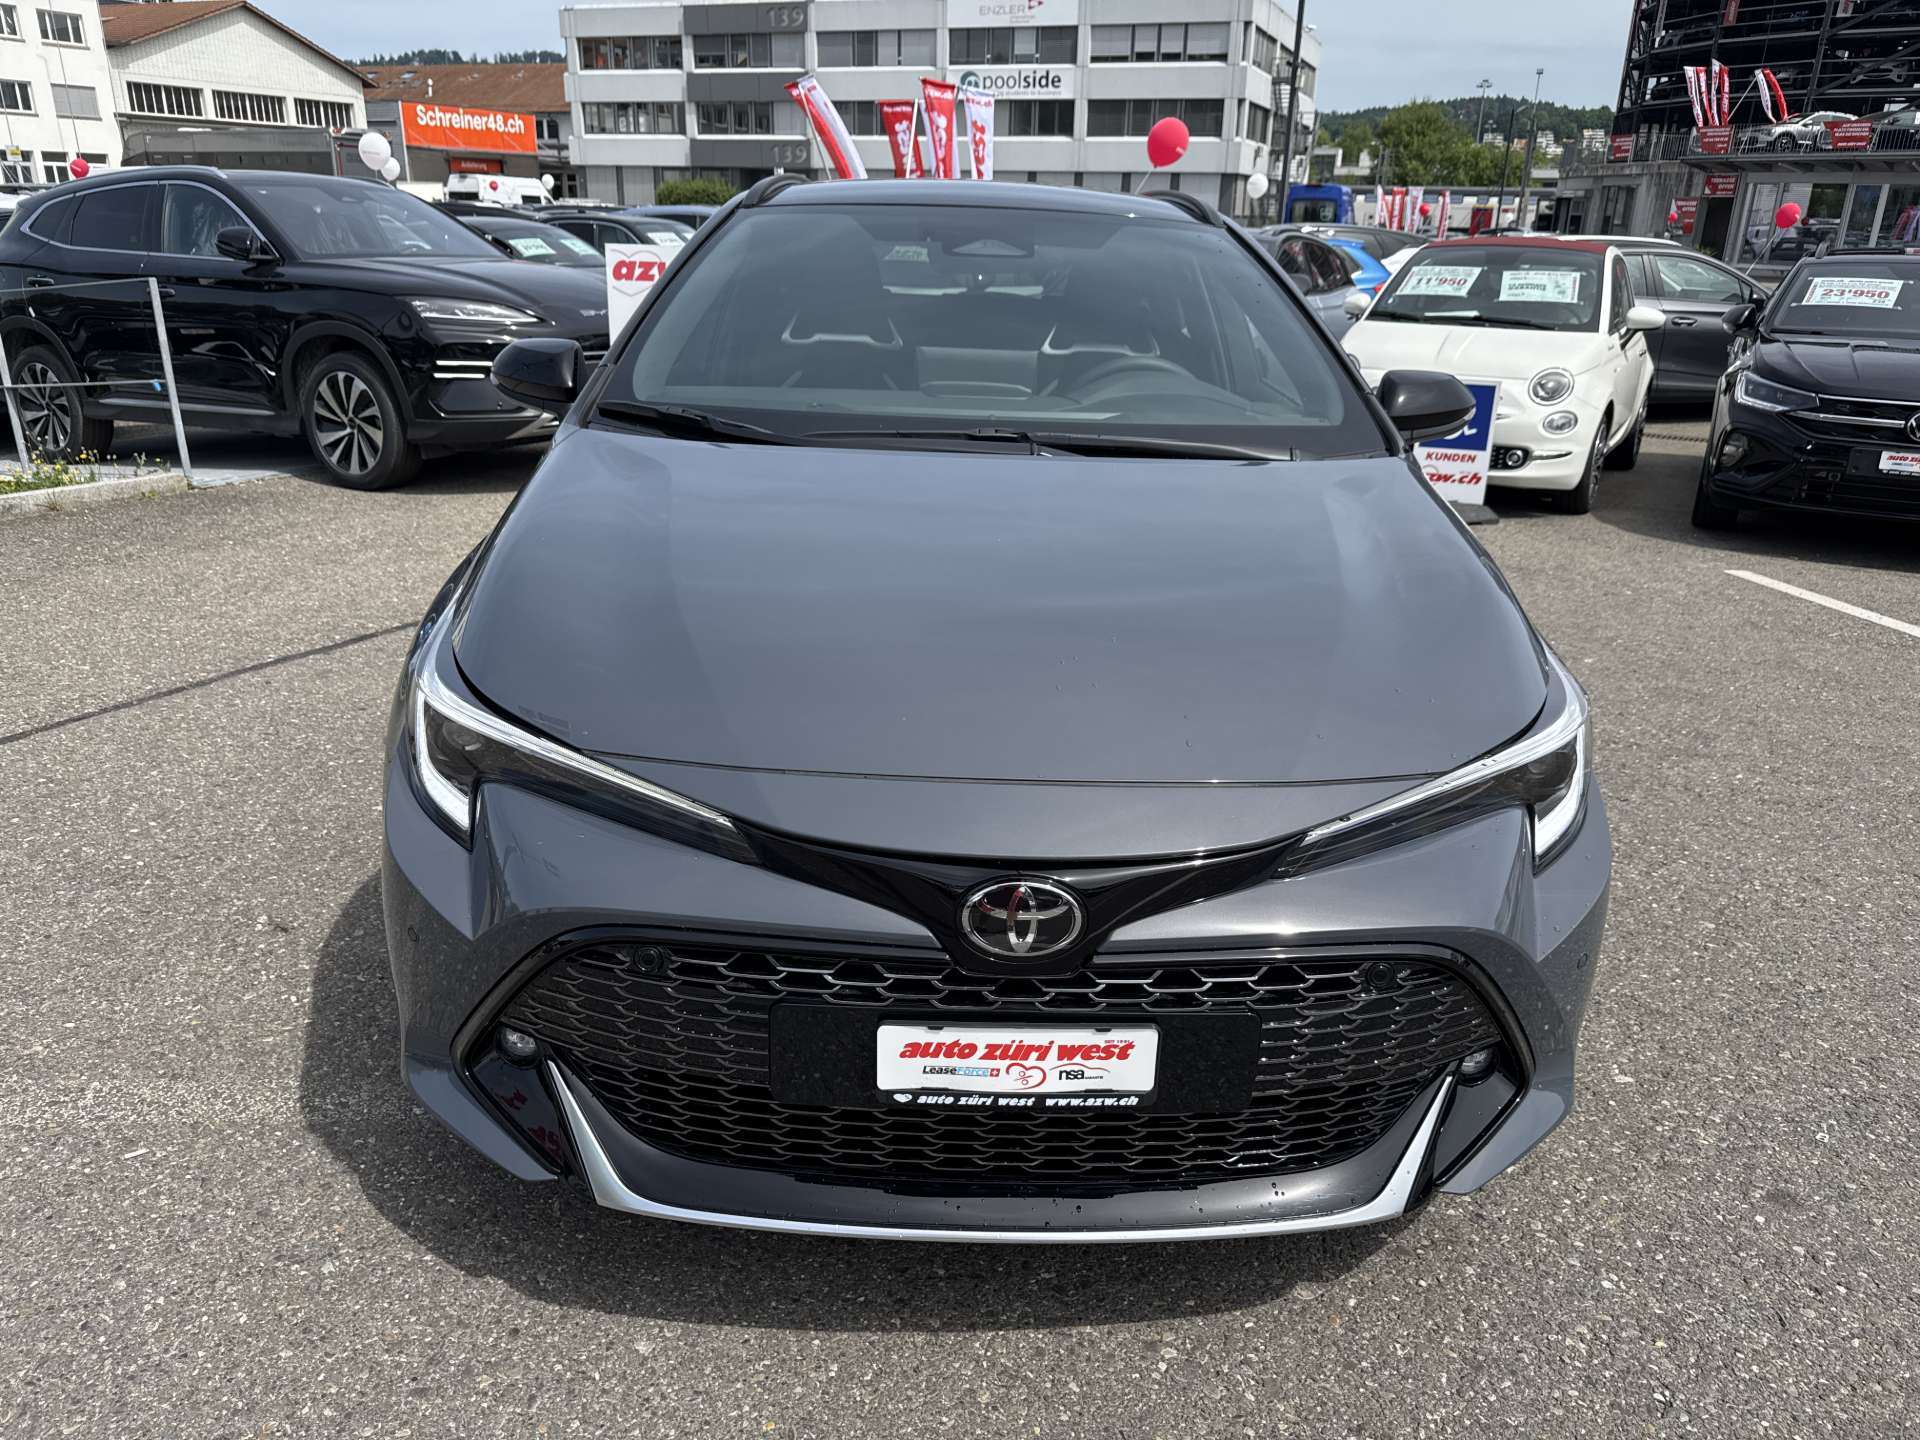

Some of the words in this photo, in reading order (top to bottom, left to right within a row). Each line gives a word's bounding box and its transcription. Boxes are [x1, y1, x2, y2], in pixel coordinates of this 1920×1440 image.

[979, 5, 1025, 16] ENZLER
[769, 9, 804, 27] 139
[983, 69, 1062, 89] poolside
[416, 104, 525, 134] Schreiner48.ch
[773, 145, 807, 163] 139
[1415, 277, 1468, 287] 11'950
[1821, 288, 1890, 299] 23'950
[1425, 452, 1477, 463] KUNDEN
[900, 1038, 978, 1059] auto
[978, 1039, 1055, 1062] züri
[1057, 1040, 1135, 1061] west
[922, 1065, 990, 1077] LeaseForce
[1058, 1069, 1085, 1080] nsa
[917, 1094, 954, 1105] auto
[957, 1094, 993, 1106] züri
[998, 1096, 1034, 1106] west
[1045, 1095, 1139, 1107] www.azw.ch
